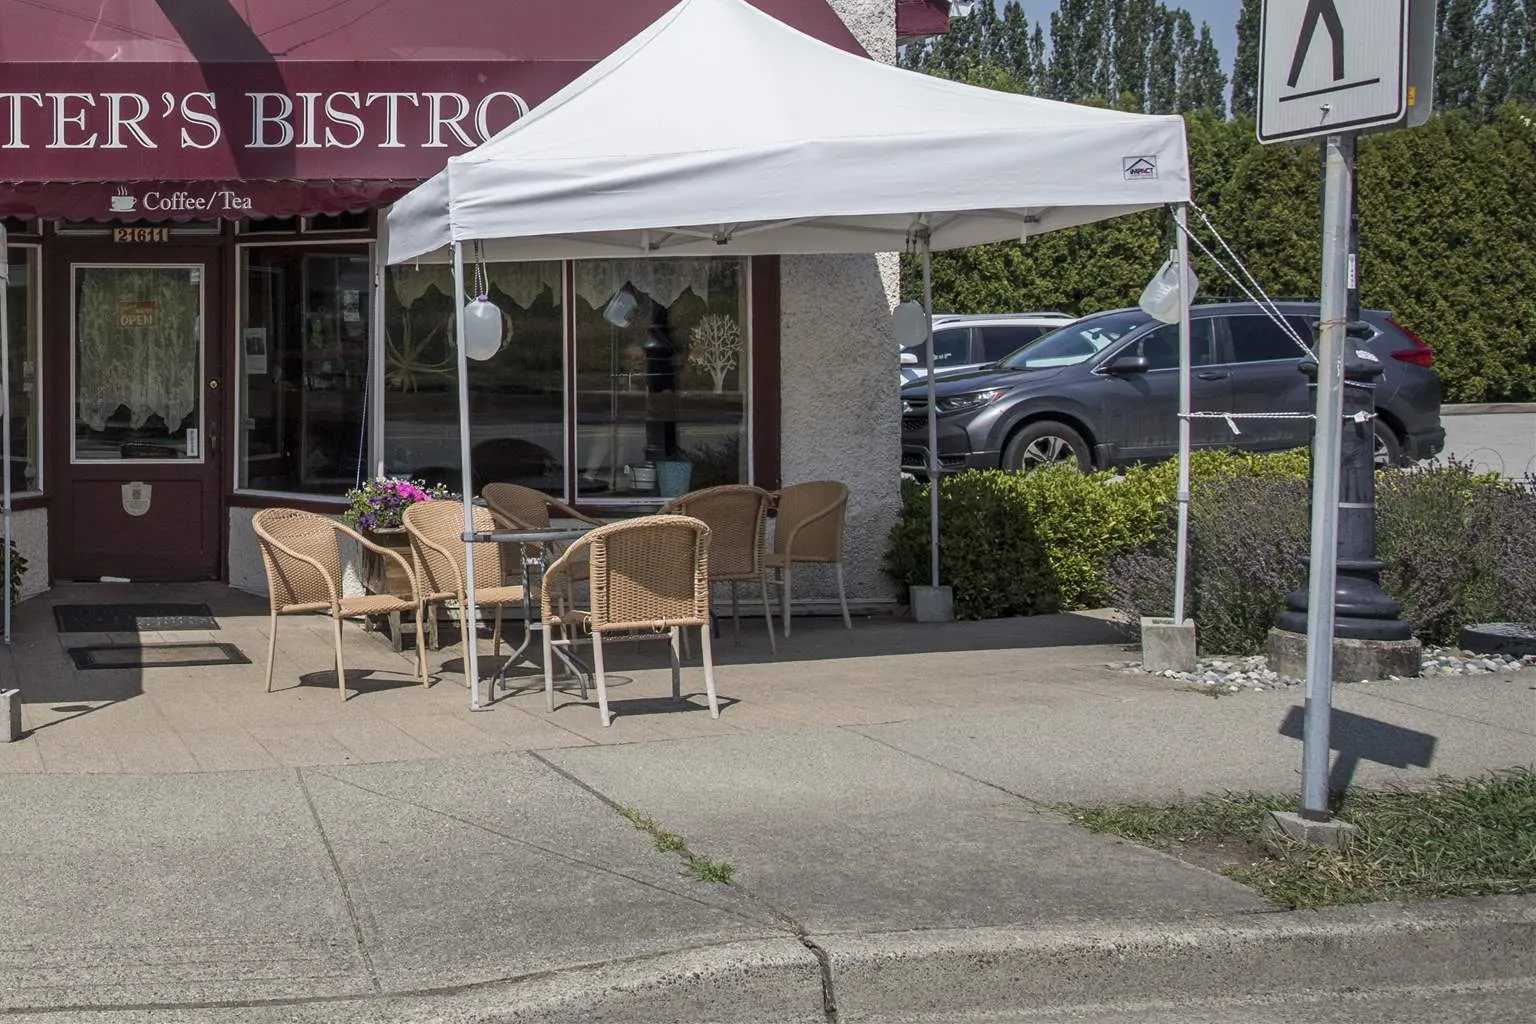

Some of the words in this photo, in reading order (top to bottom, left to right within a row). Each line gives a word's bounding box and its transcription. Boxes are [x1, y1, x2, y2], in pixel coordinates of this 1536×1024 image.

[245, 92, 530, 149] BISTRO
[143, 191, 253, 210] Coffee/Tea
[118, 228, 163, 243] 21611
[120, 314, 153, 326] OPEN
